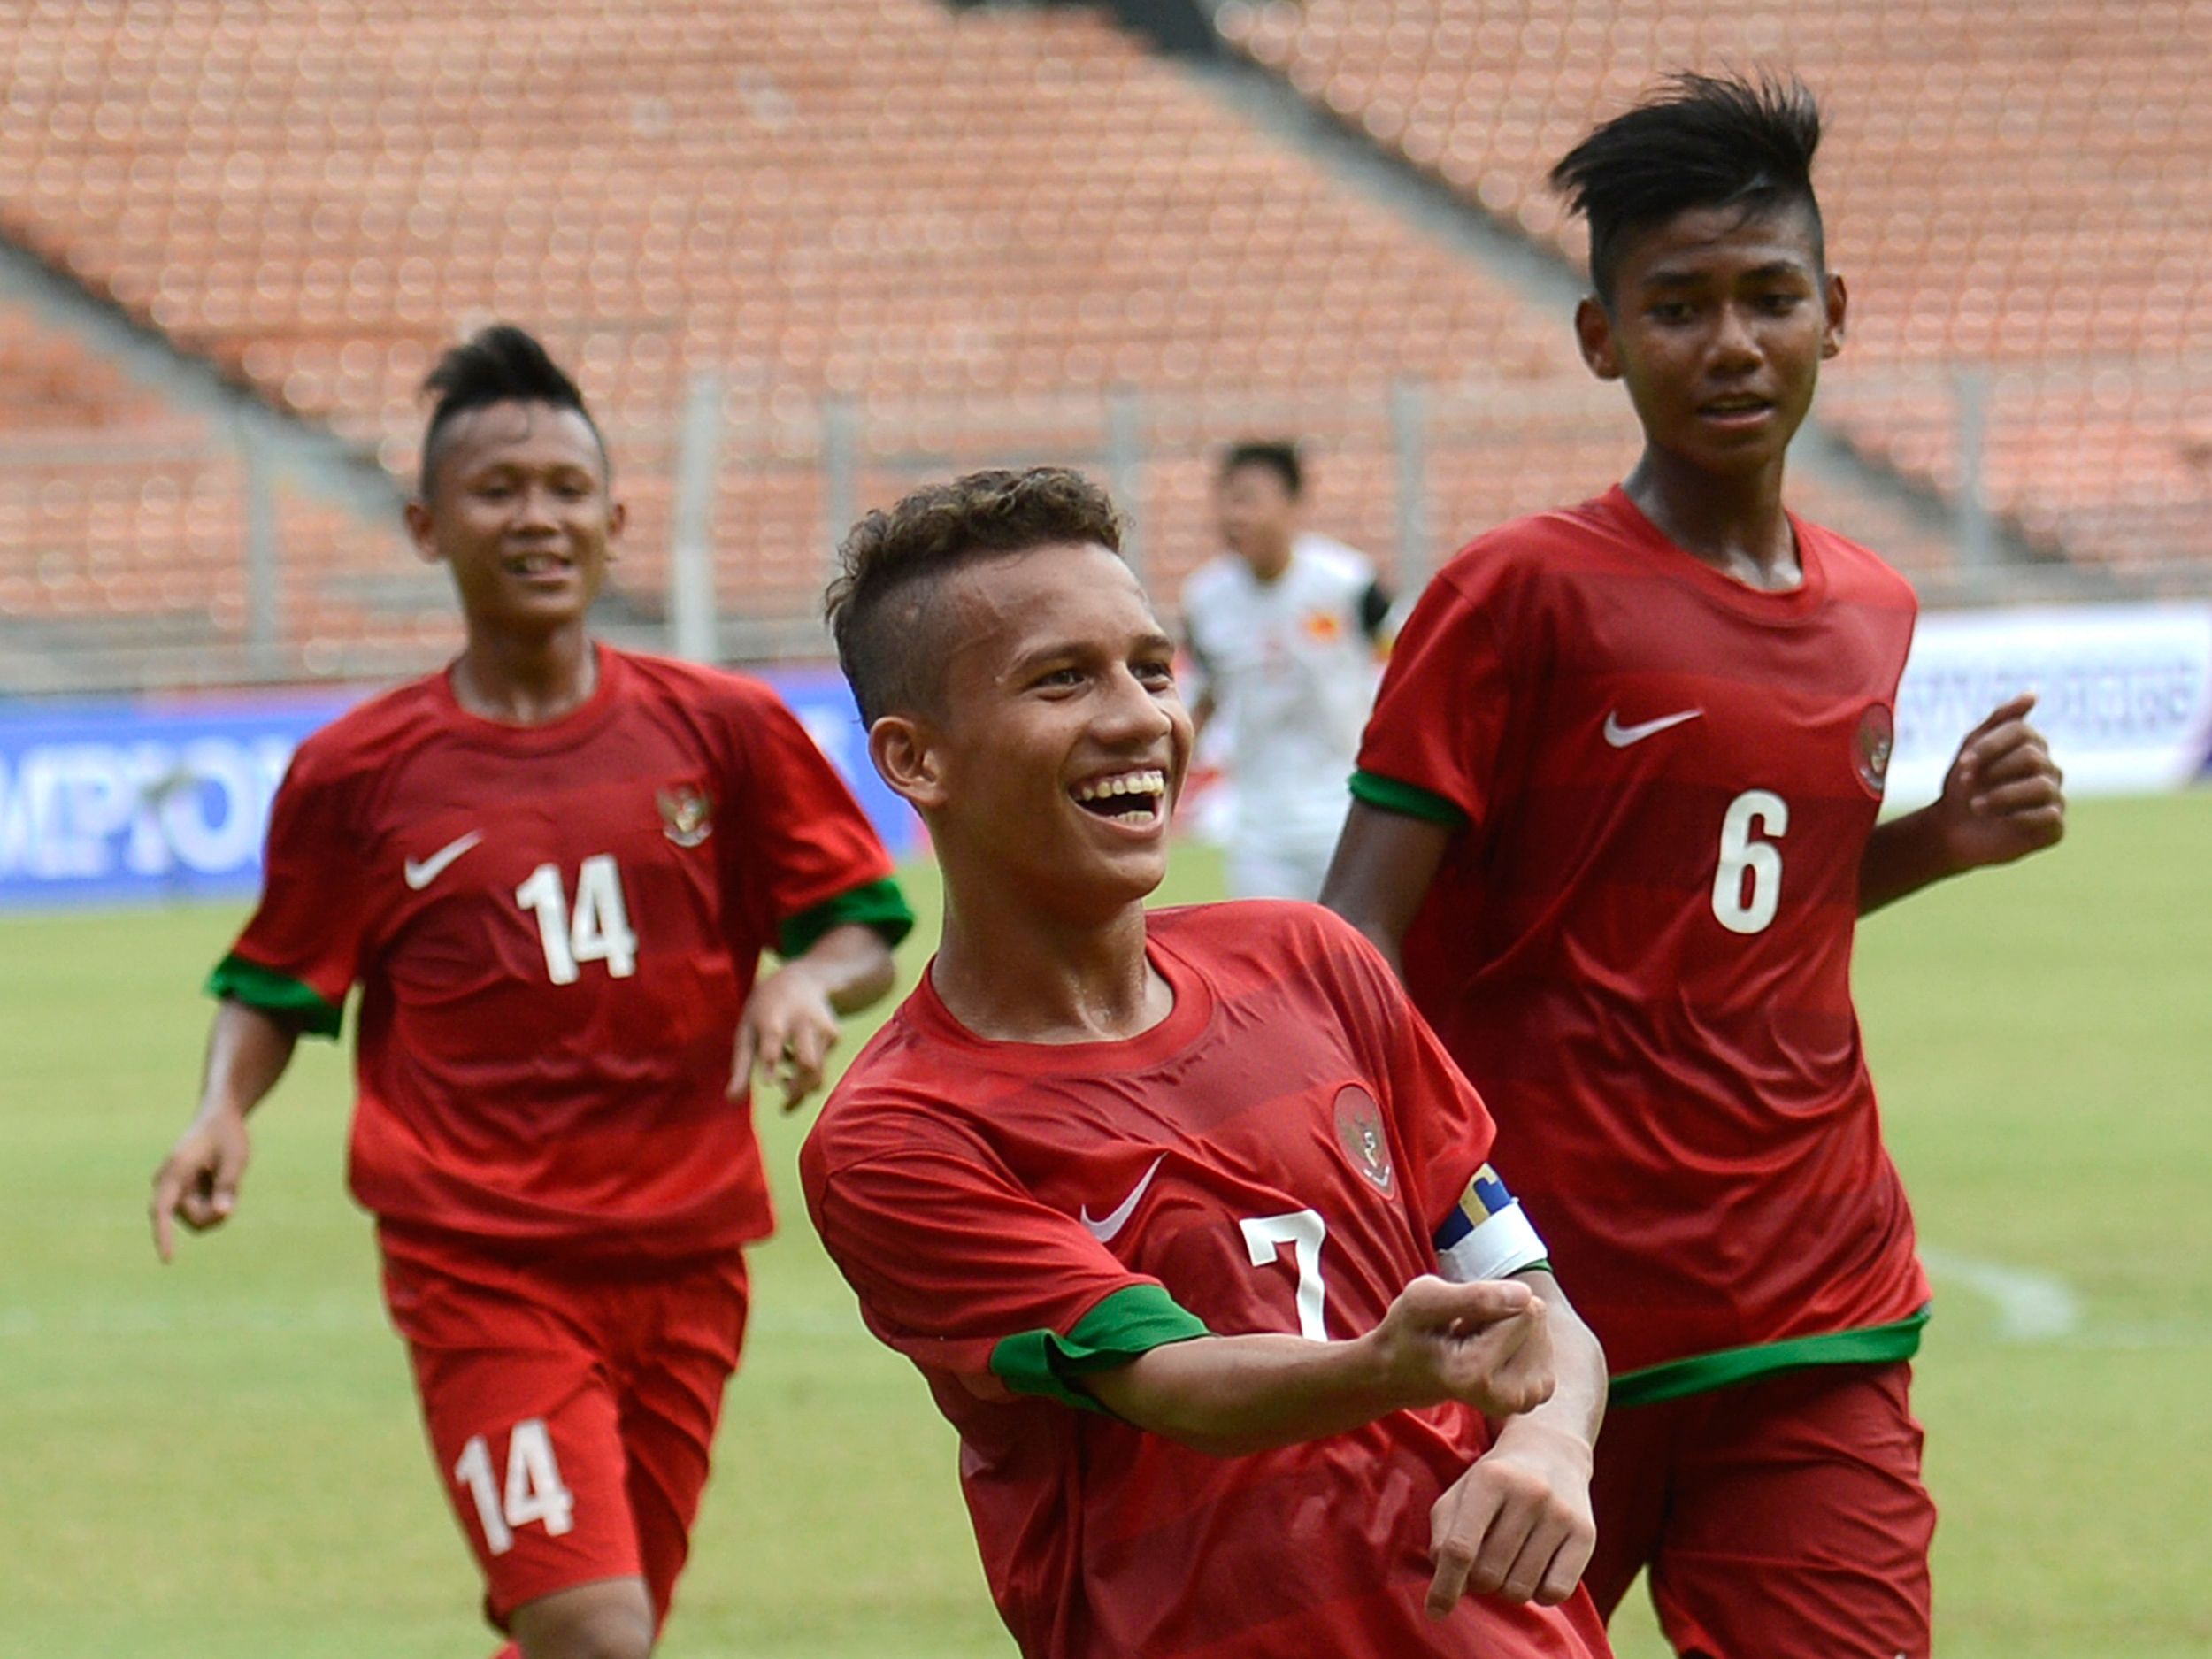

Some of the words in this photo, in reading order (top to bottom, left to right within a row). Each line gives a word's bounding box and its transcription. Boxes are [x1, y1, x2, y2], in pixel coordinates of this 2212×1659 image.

[515, 853, 639, 985] 14
[1711, 788, 1789, 934] 6
[1239, 1209, 1327, 1343] 7
[454, 1418, 573, 1556] 14
